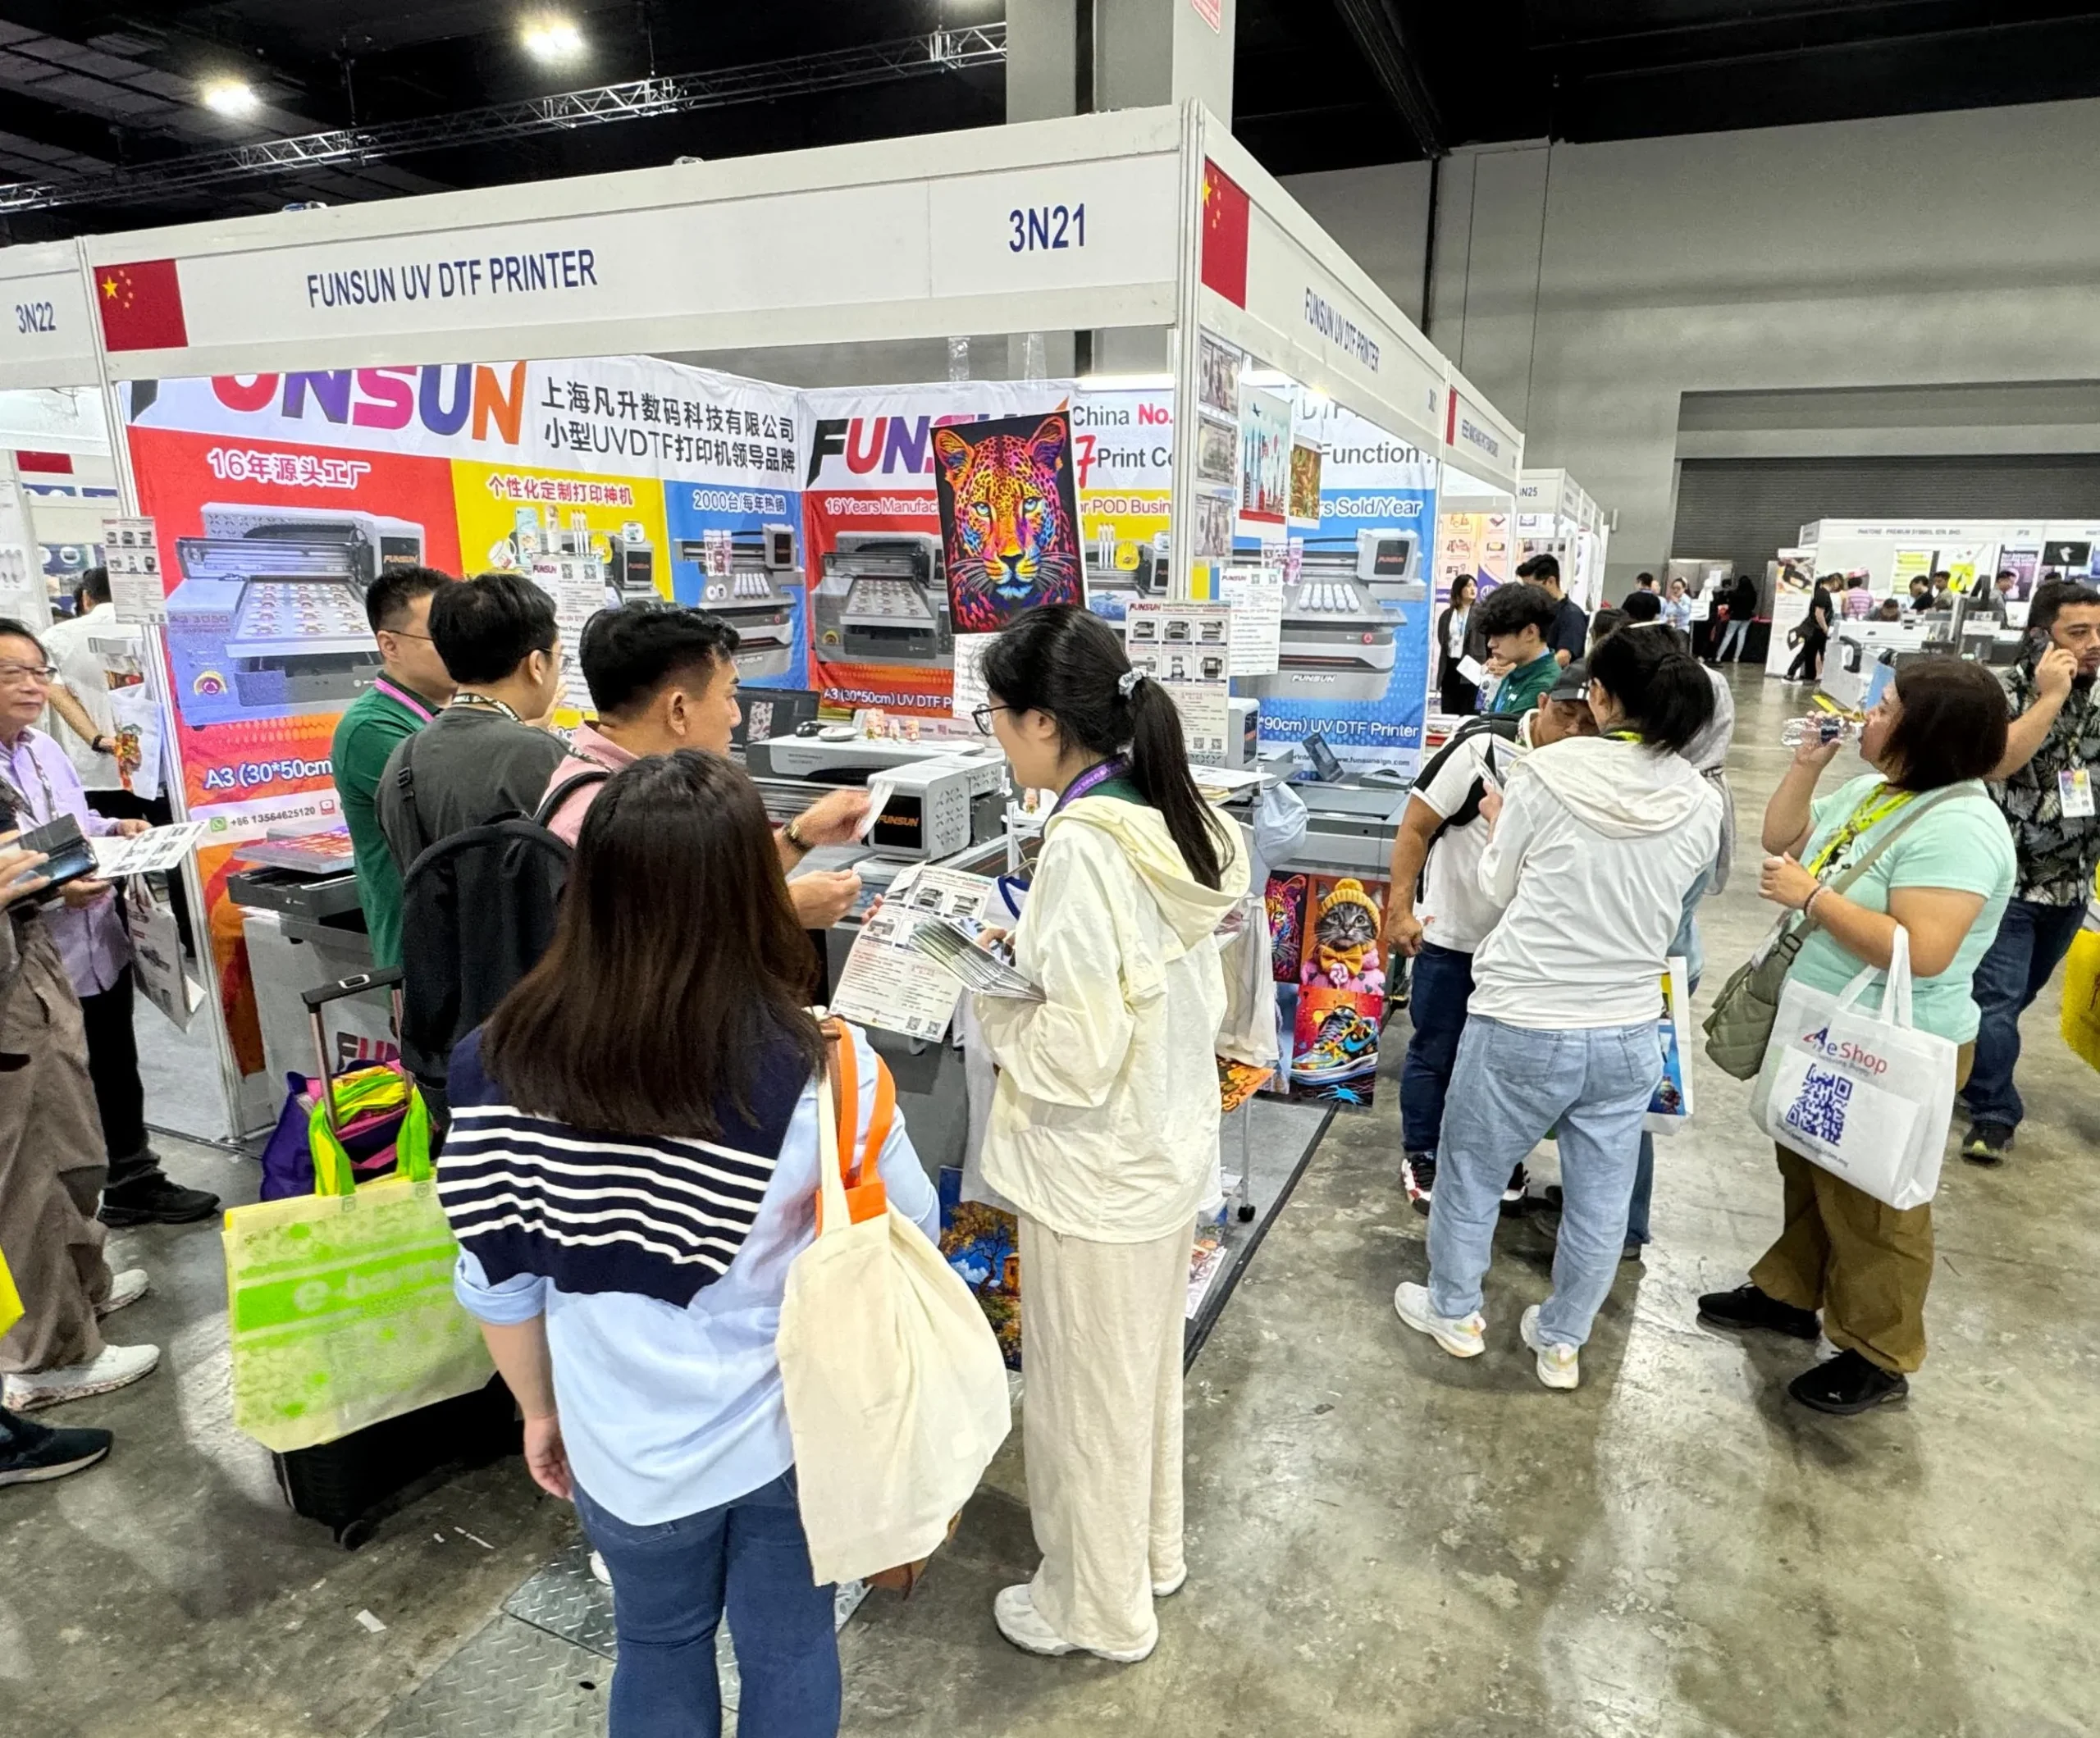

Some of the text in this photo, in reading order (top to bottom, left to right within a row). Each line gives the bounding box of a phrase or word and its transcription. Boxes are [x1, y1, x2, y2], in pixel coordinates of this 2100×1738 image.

[1009, 203, 1084, 253] 3N21
[307, 249, 598, 308] FUNSUN UV DTF PRINTER
[16, 301, 57, 334] 3N22
[1304, 286, 1334, 340] FUNSUN
[1356, 330, 1380, 374] PRINTER
[541, 376, 795, 444] 上海凡升数码科技有限公司
[1072, 404, 1130, 427] China
[545, 417, 796, 474] 小型UVDTF打印机领导品牌
[208, 449, 371, 490] 16年源头工厂
[1075, 434, 1097, 489] 7
[1098, 447, 1146, 468] Print
[487, 474, 634, 507] 个性化定制打印神机
[693, 492, 787, 514] 2000台/每年热销
[826, 498, 938, 514] 16 Years Manufac
[1093, 499, 1127, 513] POD
[1338, 498, 1422, 516] Sold/Year
[1129, 603, 1162, 612] FUNSUN
[1291, 674, 1337, 683] FUNSUN
[824, 687, 838, 699] A3
[897, 696, 915, 707] UV
[916, 696, 941, 709] DTF
[1310, 718, 1334, 733] UV
[1335, 719, 1367, 734] DTF
[1370, 722, 1419, 737] Printer
[205, 765, 235, 789] A3
[231, 817, 249, 827] +86
[877, 814, 919, 828] FUNSUN
